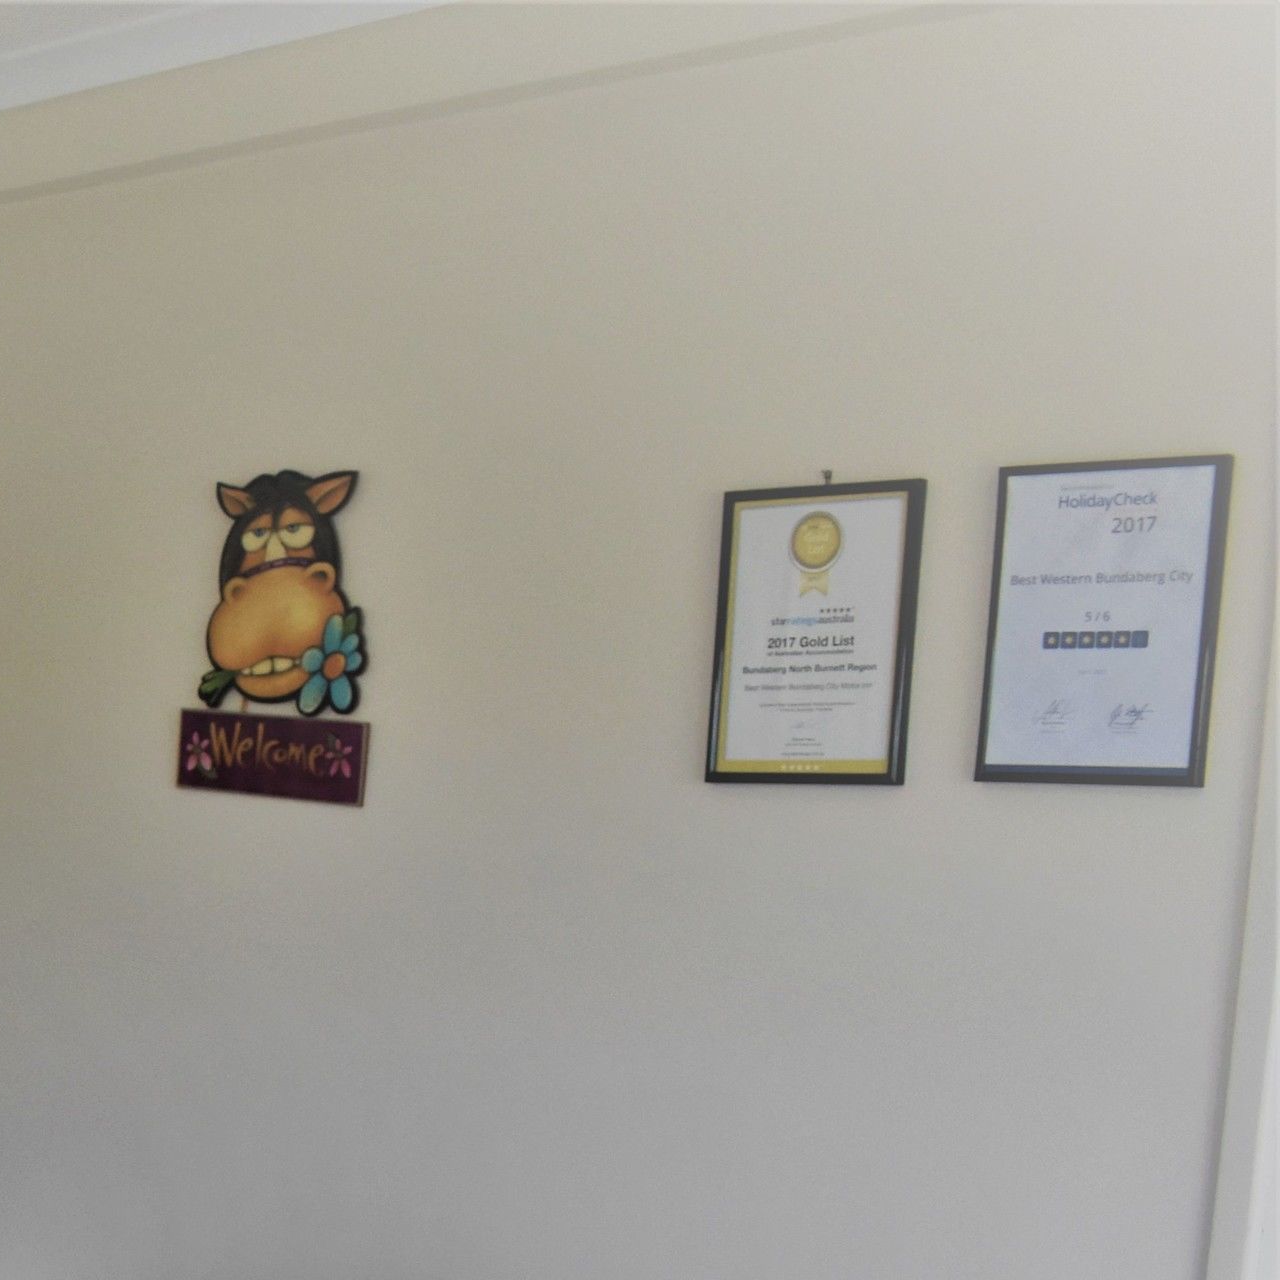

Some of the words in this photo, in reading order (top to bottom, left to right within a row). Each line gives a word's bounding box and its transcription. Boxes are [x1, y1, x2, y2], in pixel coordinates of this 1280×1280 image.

[1058, 492, 1158, 511] HolidayCheck
[1111, 516, 1158, 534] 2017
[1009, 574, 1037, 586] Best
[1040, 573, 1091, 585] Western
[1096, 571, 1166, 585] Bundaberg
[1169, 570, 1194, 583] City
[767, 637, 796, 649] 2017
[799, 636, 829, 648] Gold
[831, 635, 855, 647] List
[742, 666, 787, 674] Bundaberg
[788, 665, 813, 673] North
[847, 663, 878, 672] Region
[210, 721, 325, 777] Welcome
